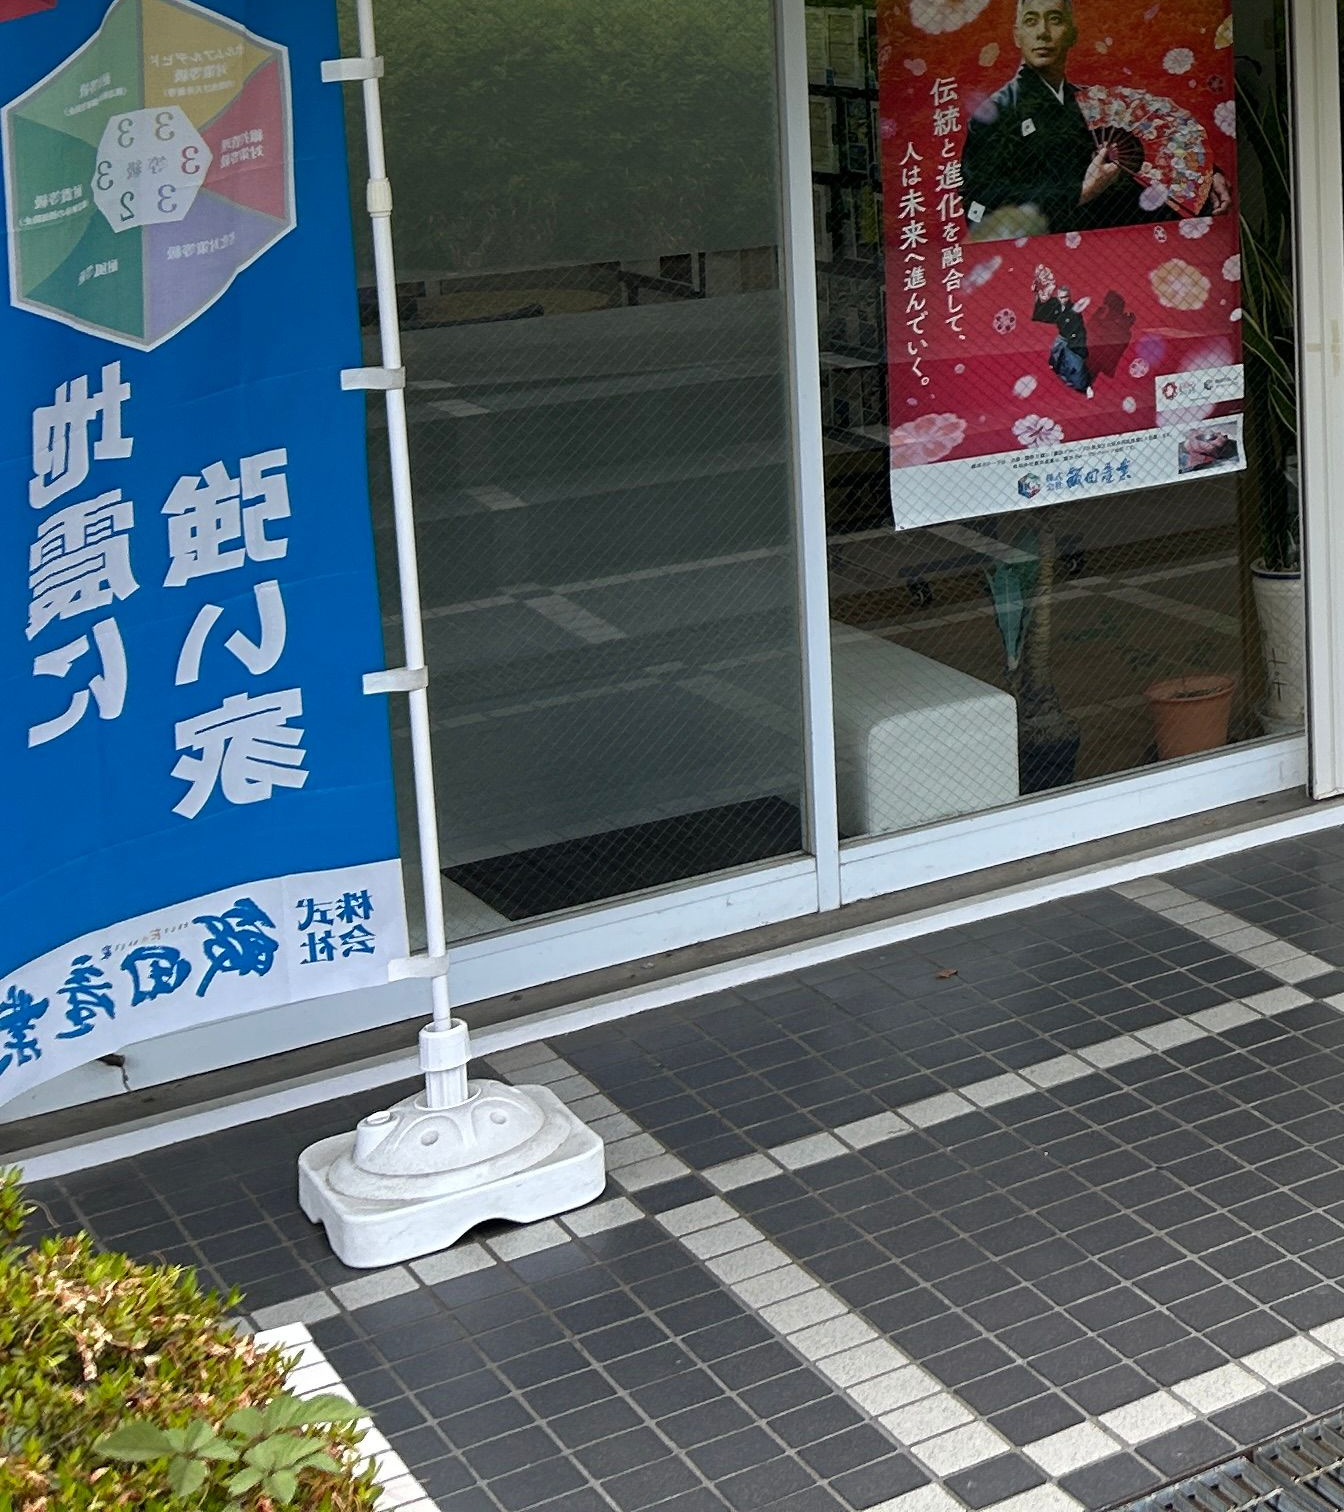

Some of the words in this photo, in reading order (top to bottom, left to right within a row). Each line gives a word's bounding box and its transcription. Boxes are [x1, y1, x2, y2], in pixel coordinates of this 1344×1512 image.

[898, 140, 931, 388] 人は未来へ進んでいく。
